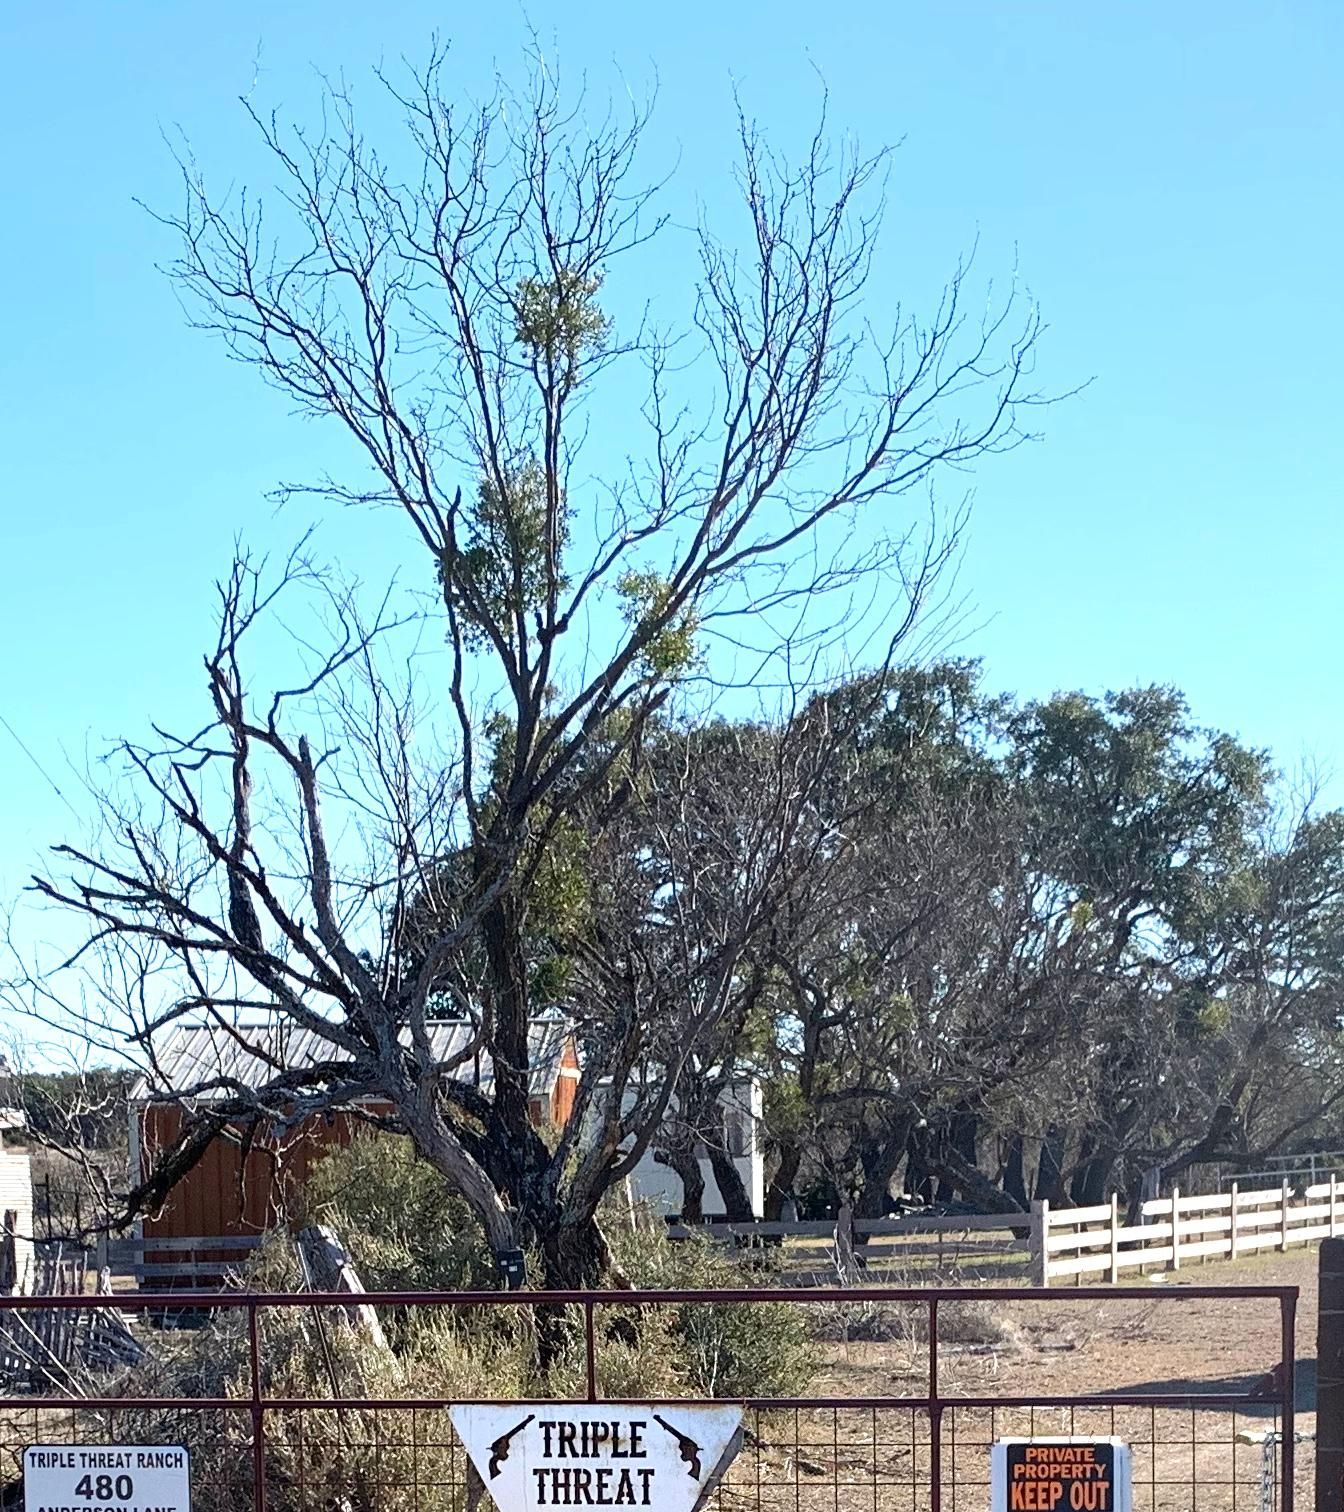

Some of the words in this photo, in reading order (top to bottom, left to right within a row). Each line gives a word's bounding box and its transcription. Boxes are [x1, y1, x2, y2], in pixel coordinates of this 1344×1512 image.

[539, 1421, 647, 1458] TRIPLE
[29, 1452, 75, 1468] TRIPLE
[79, 1452, 132, 1468] THREAT
[137, 1452, 183, 1469] RANCH
[1025, 1447, 1095, 1462] PRIVATE
[1013, 1463, 1106, 1479] PROPERTY
[75, 1474, 133, 1500] 480
[533, 1468, 655, 1505] THREAT
[1011, 1481, 1063, 1511] KEEP
[1069, 1481, 1110, 1511] OUT
